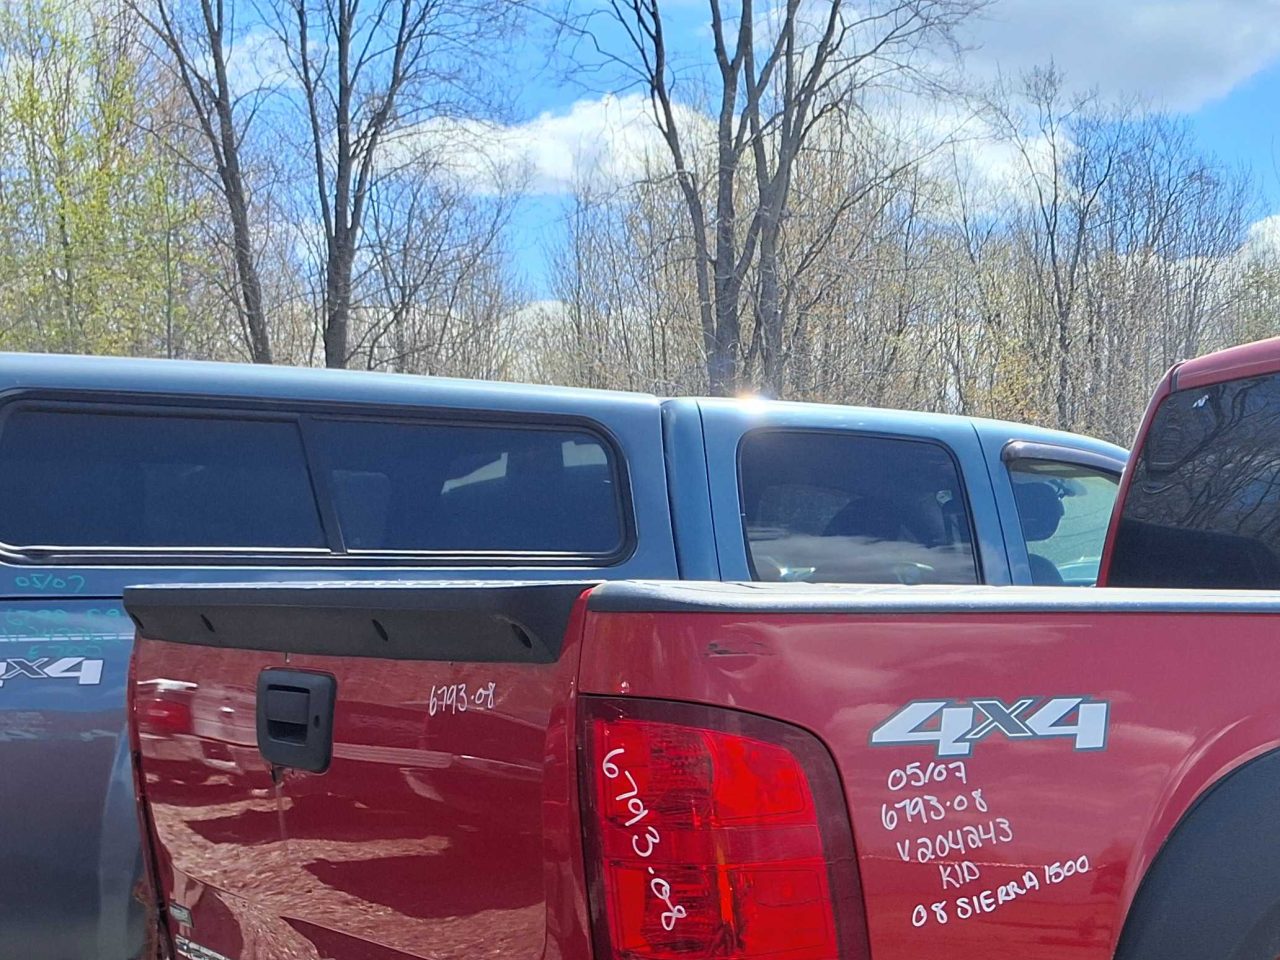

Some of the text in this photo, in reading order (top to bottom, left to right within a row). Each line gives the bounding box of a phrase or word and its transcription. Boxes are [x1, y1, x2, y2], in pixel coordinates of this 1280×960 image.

[910, 854, 1090, 928] 08 SIERRA 1500
